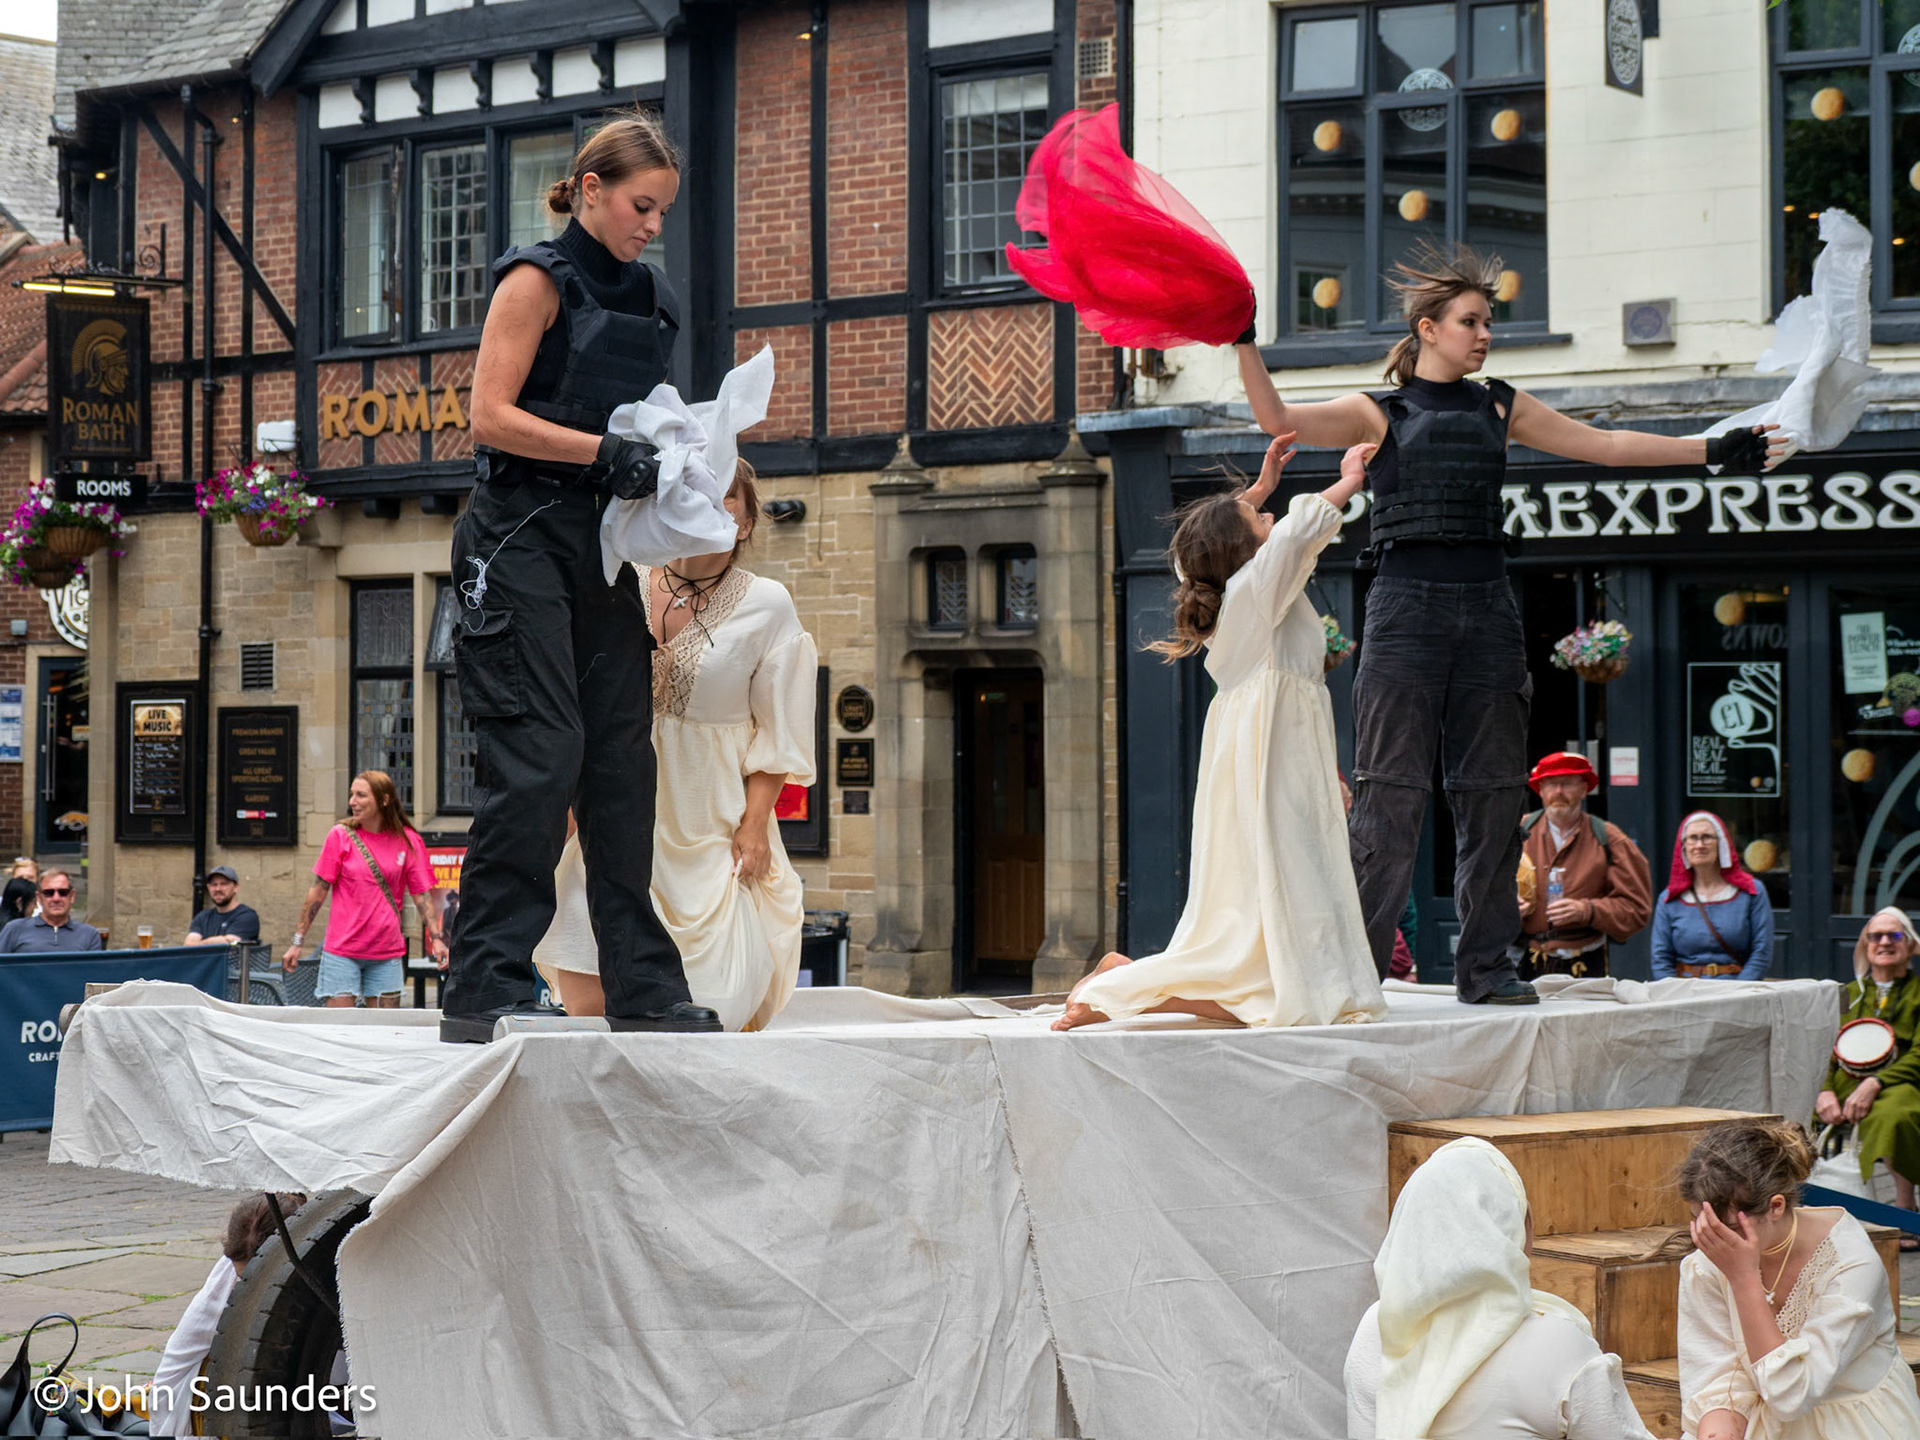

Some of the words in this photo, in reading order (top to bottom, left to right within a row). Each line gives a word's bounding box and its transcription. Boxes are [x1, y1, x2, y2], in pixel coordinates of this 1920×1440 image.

[62, 397, 139, 426] ROMAN
[79, 423, 125, 442] BATH
[76, 480, 132, 497] ROOMS
[148, 710, 167, 719] LIVE
[1719, 702, 1745, 730] £1
[143, 721, 172, 732] MUSIC
[430, 854, 457, 866] FRIDAY
[28, 1051, 60, 1063] CRAFT
